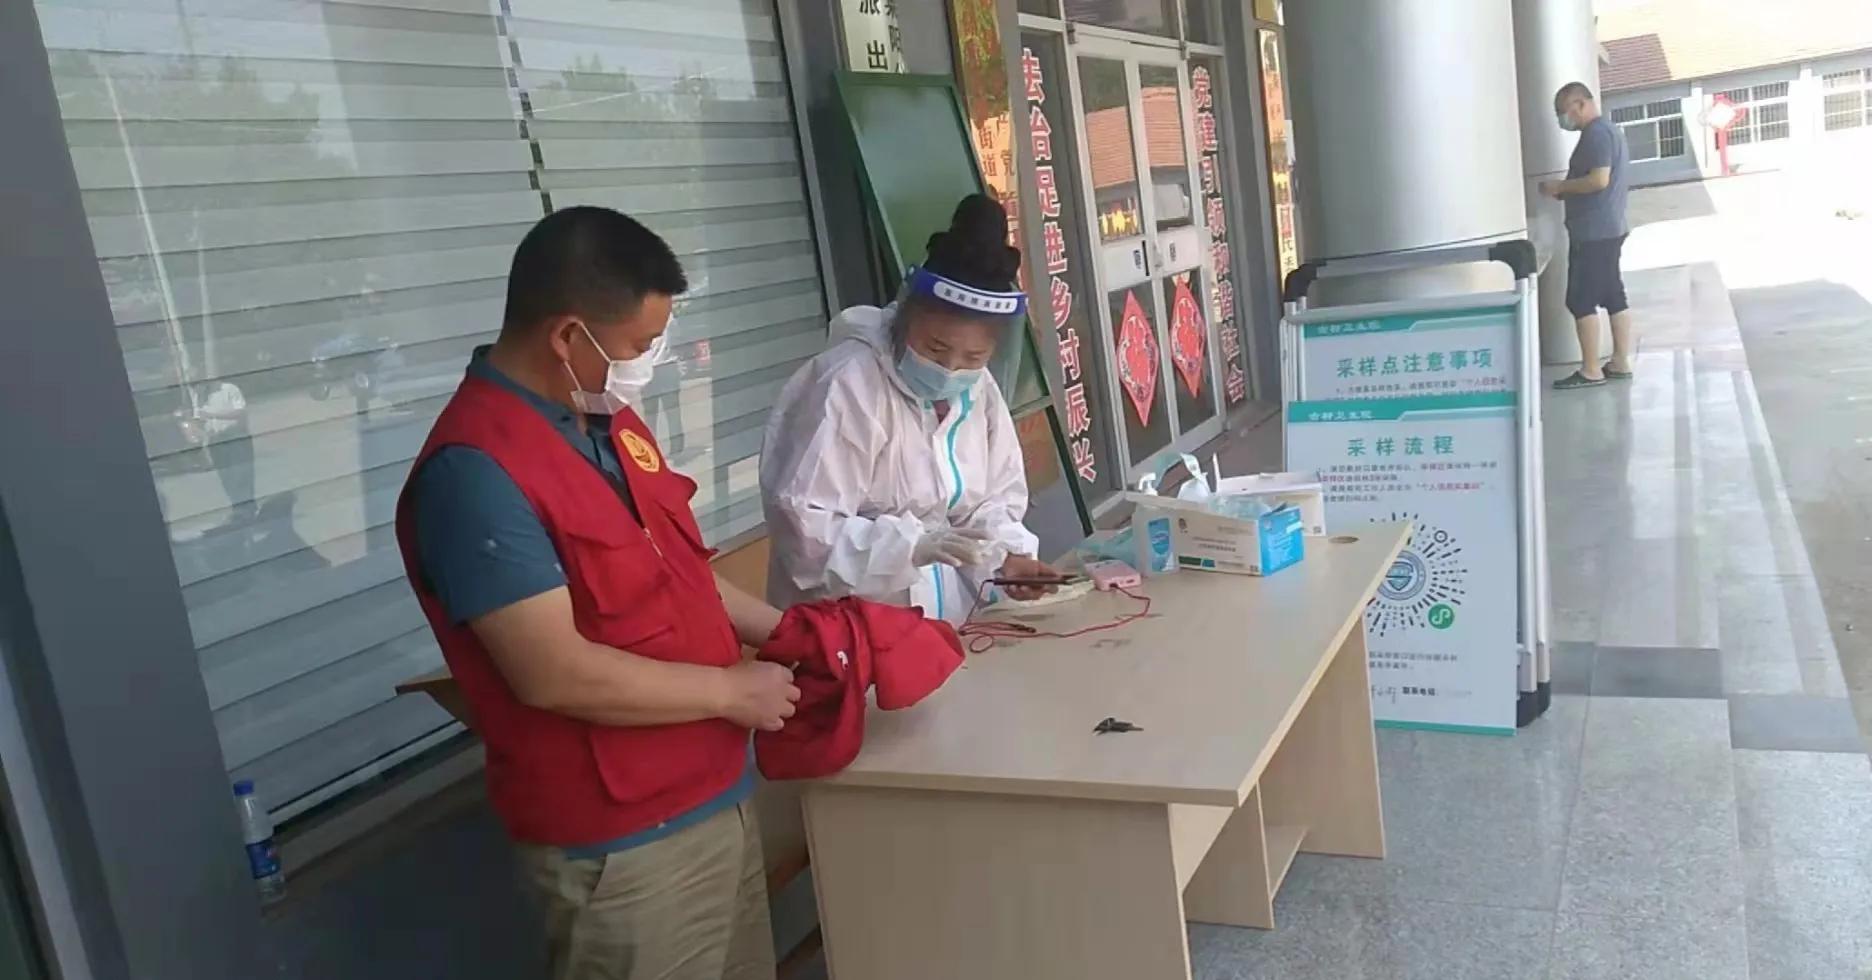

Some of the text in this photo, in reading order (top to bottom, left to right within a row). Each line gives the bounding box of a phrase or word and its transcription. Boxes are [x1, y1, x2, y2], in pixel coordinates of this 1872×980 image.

[1336, 347, 1493, 379] 采样点注意事项
[1347, 435, 1455, 457] 采样流程
